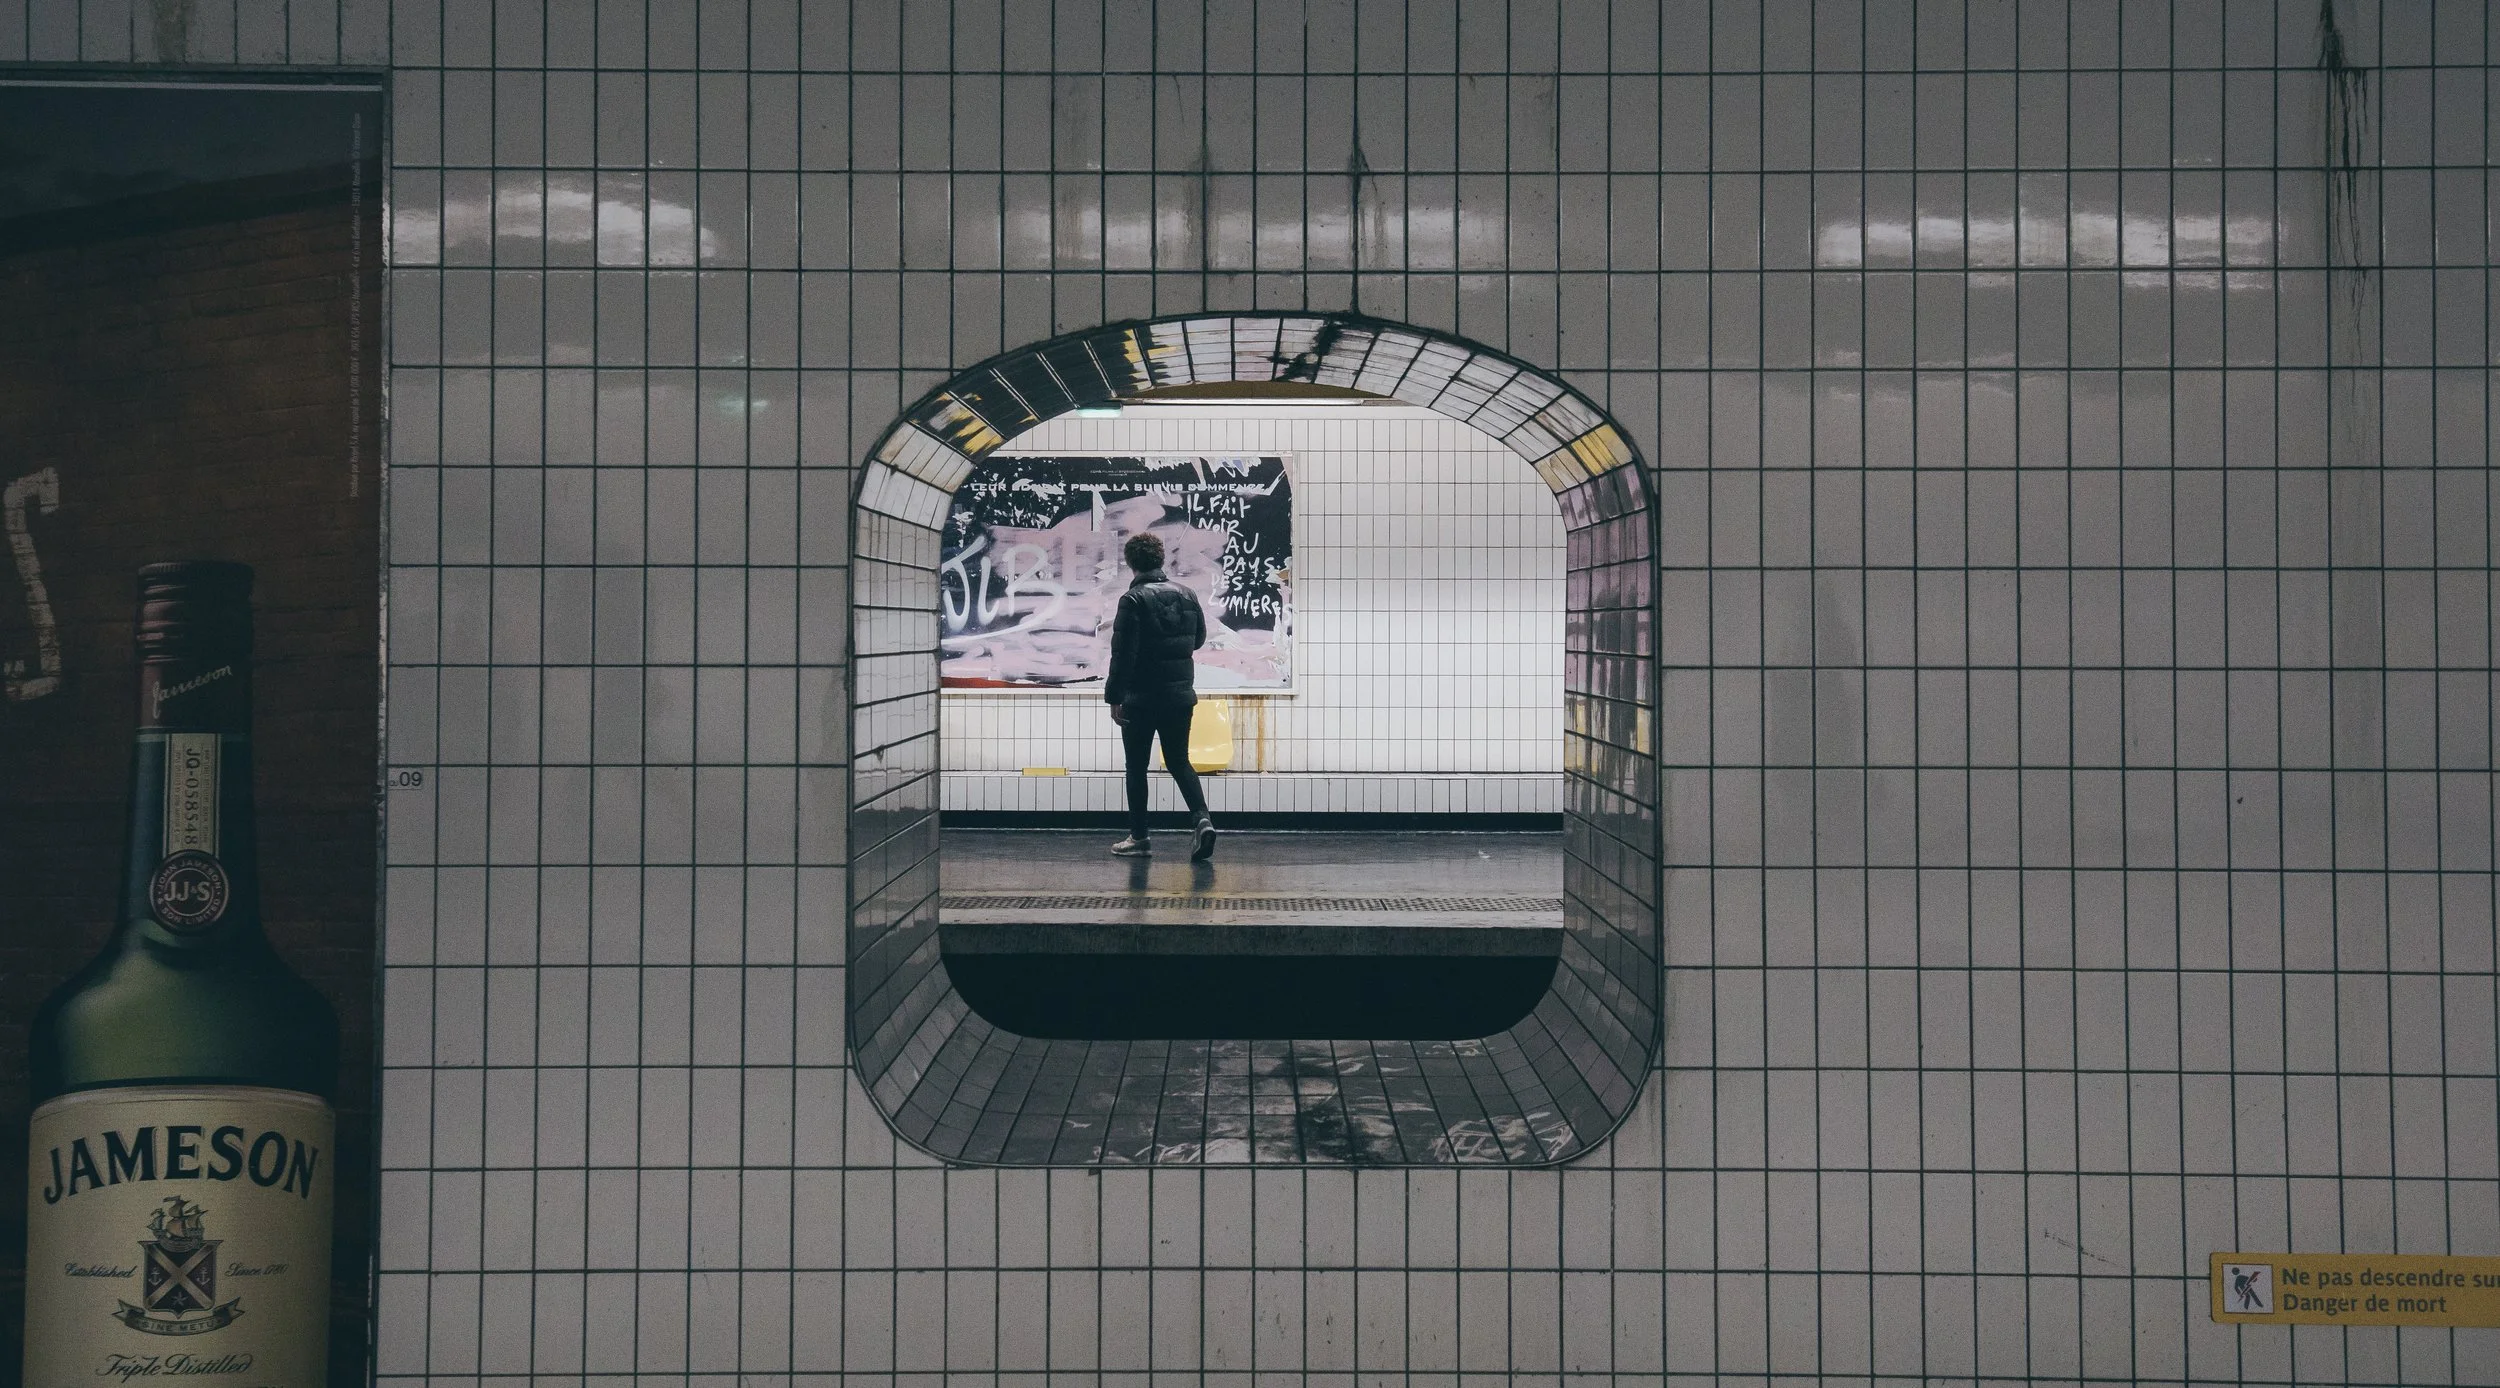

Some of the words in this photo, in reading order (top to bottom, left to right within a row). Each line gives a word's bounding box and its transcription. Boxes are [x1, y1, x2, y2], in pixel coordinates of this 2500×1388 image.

[1113, 483, 1129, 491] LA
[1225, 532, 1259, 555] AU
[43, 1125, 319, 1205] JAMESON
[2282, 1268, 2310, 1285] Ne
[2318, 1271, 2353, 1289] pas
[2360, 1267, 2465, 1287] descendre
[2283, 1293, 2357, 1316] Danger
[2365, 1293, 2390, 1312] de
[2397, 1296, 2447, 1313] mort
[97, 1353, 161, 1384] Triple
[162, 1353, 254, 1376] Distilled
